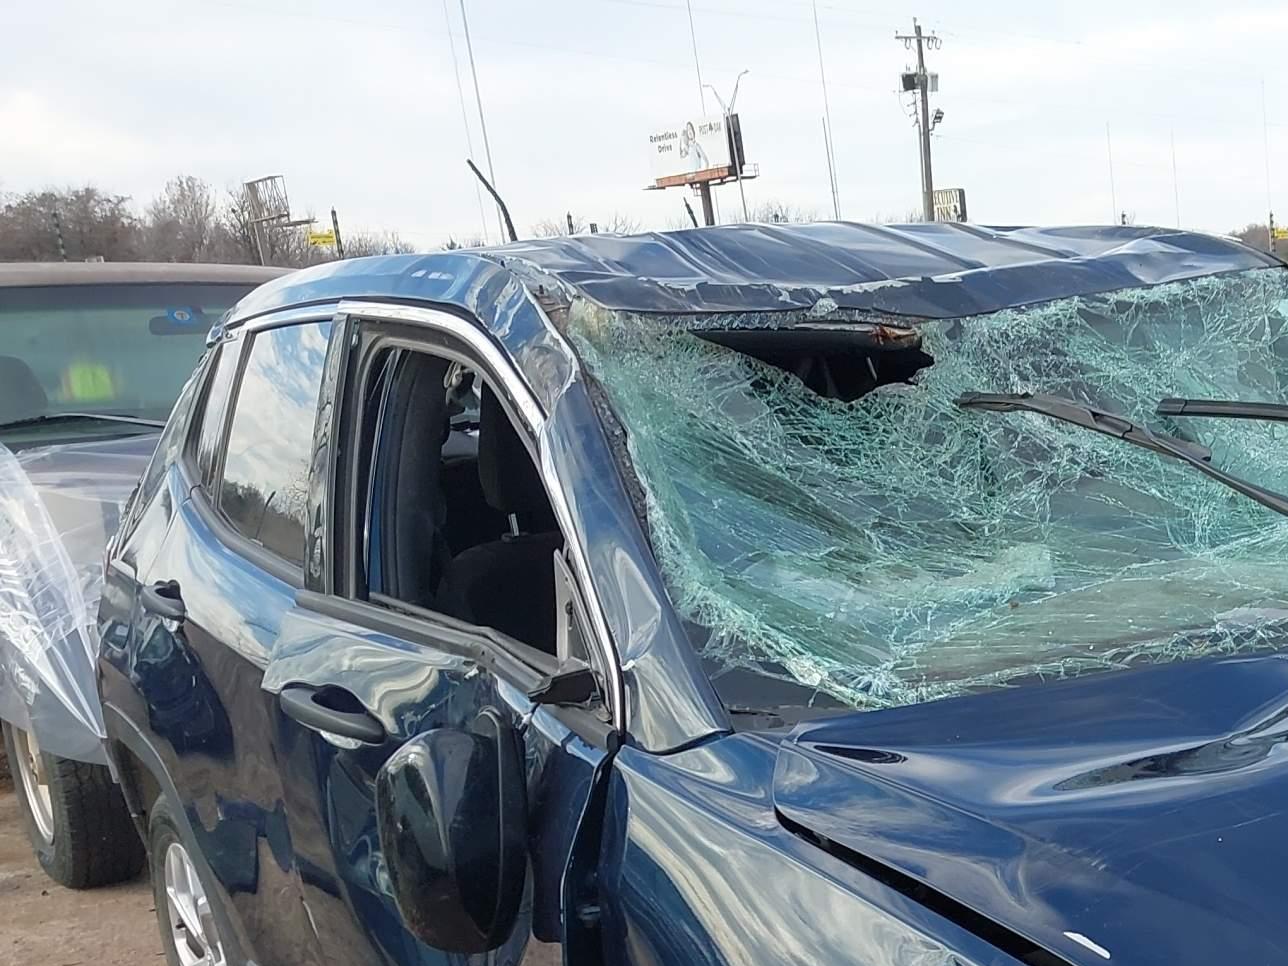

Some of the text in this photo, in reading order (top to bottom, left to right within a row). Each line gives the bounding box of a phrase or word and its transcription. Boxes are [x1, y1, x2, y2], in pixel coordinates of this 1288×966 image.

[649, 131, 678, 143] Relentless
[657, 144, 673, 153] Drive
[933, 191, 959, 206] ECUTIVE
[936, 206, 952, 222] INN
